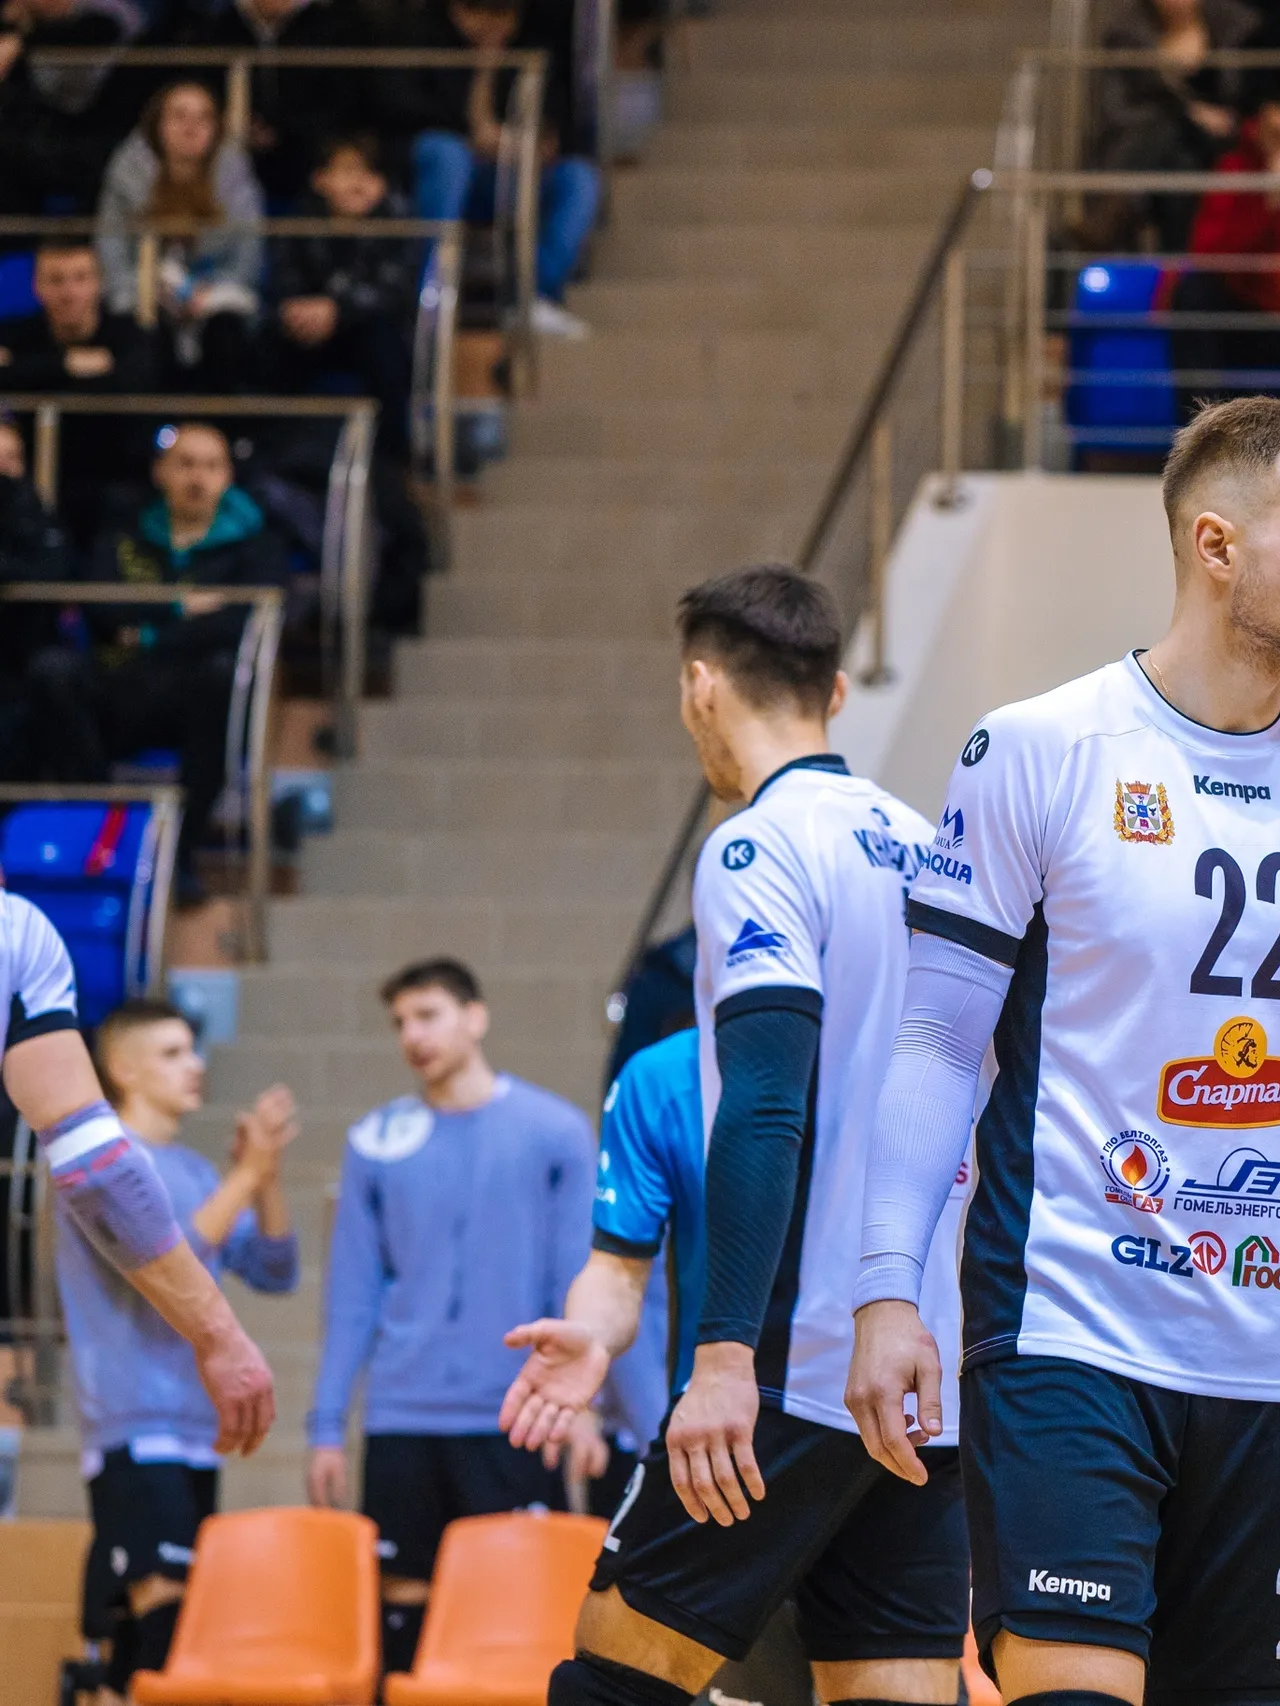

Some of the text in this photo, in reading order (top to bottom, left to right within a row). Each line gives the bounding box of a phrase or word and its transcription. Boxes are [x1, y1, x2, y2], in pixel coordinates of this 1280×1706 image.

[1193, 775, 1271, 804] Kempa
[1102, 1130, 1169, 1163] ГПО БЕЛТОПГАЗ
[1028, 1569, 1111, 1603] Kempa
